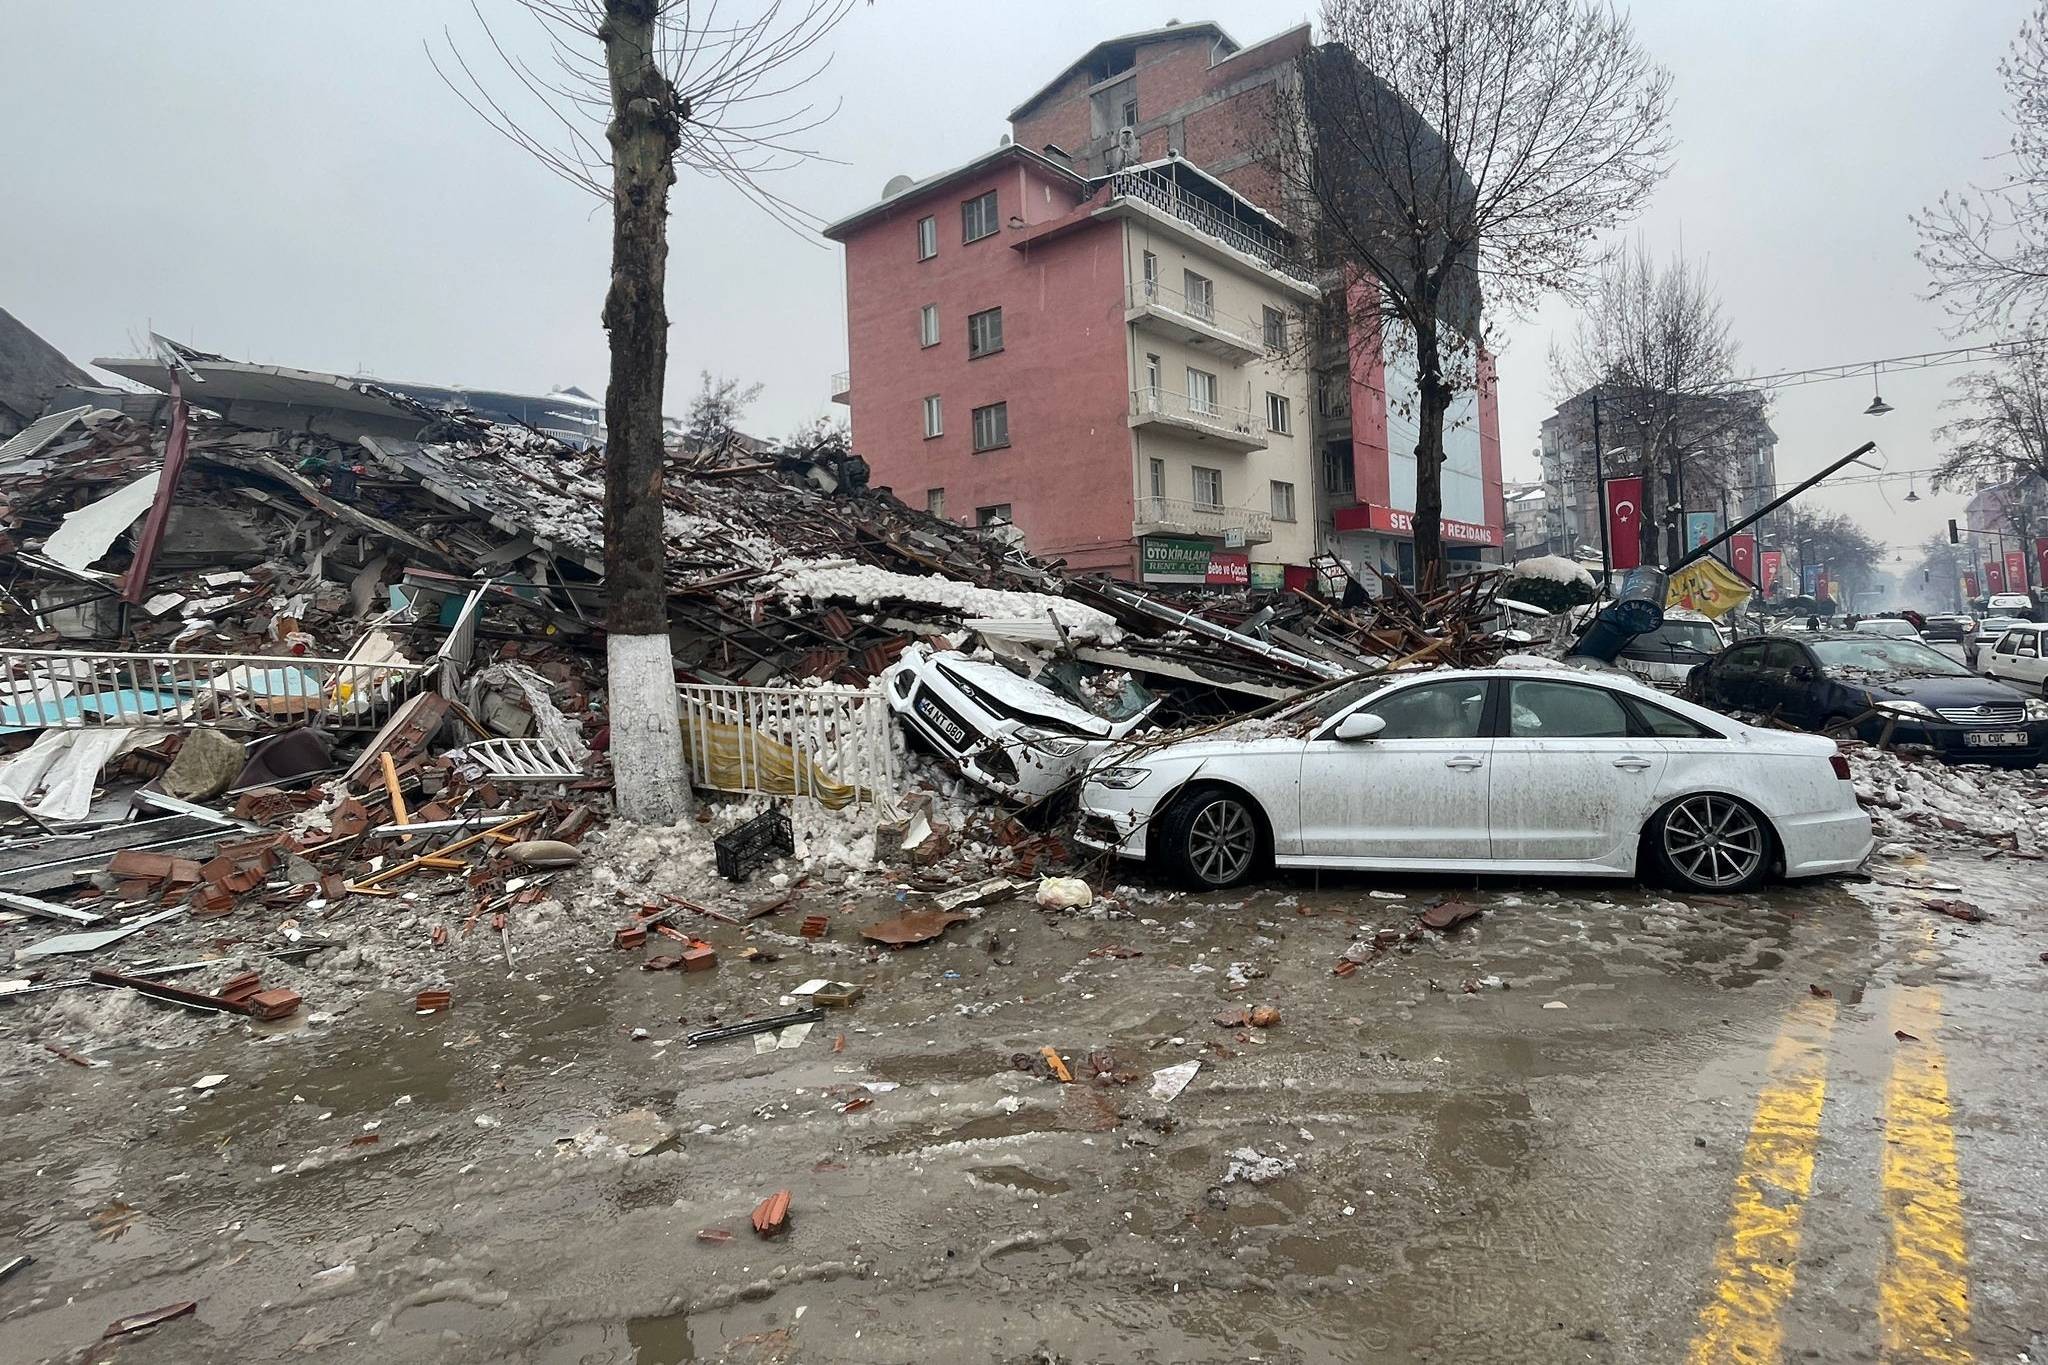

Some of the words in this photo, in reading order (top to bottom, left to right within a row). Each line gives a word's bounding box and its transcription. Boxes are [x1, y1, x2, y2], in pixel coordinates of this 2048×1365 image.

[1448, 523, 1492, 542] REZİDANS
[1147, 547, 1167, 559] OTO
[1168, 544, 1210, 561] KİRALAMA
[1149, 562, 1177, 570] RENT
[1207, 562, 1223, 575] Bebe
[1223, 566, 1230, 575] ve
[933, 710, 948, 726] NT
[945, 722, 963, 741] 080
[1971, 734, 1981, 743] 01
[2016, 733, 2026, 743] 12
